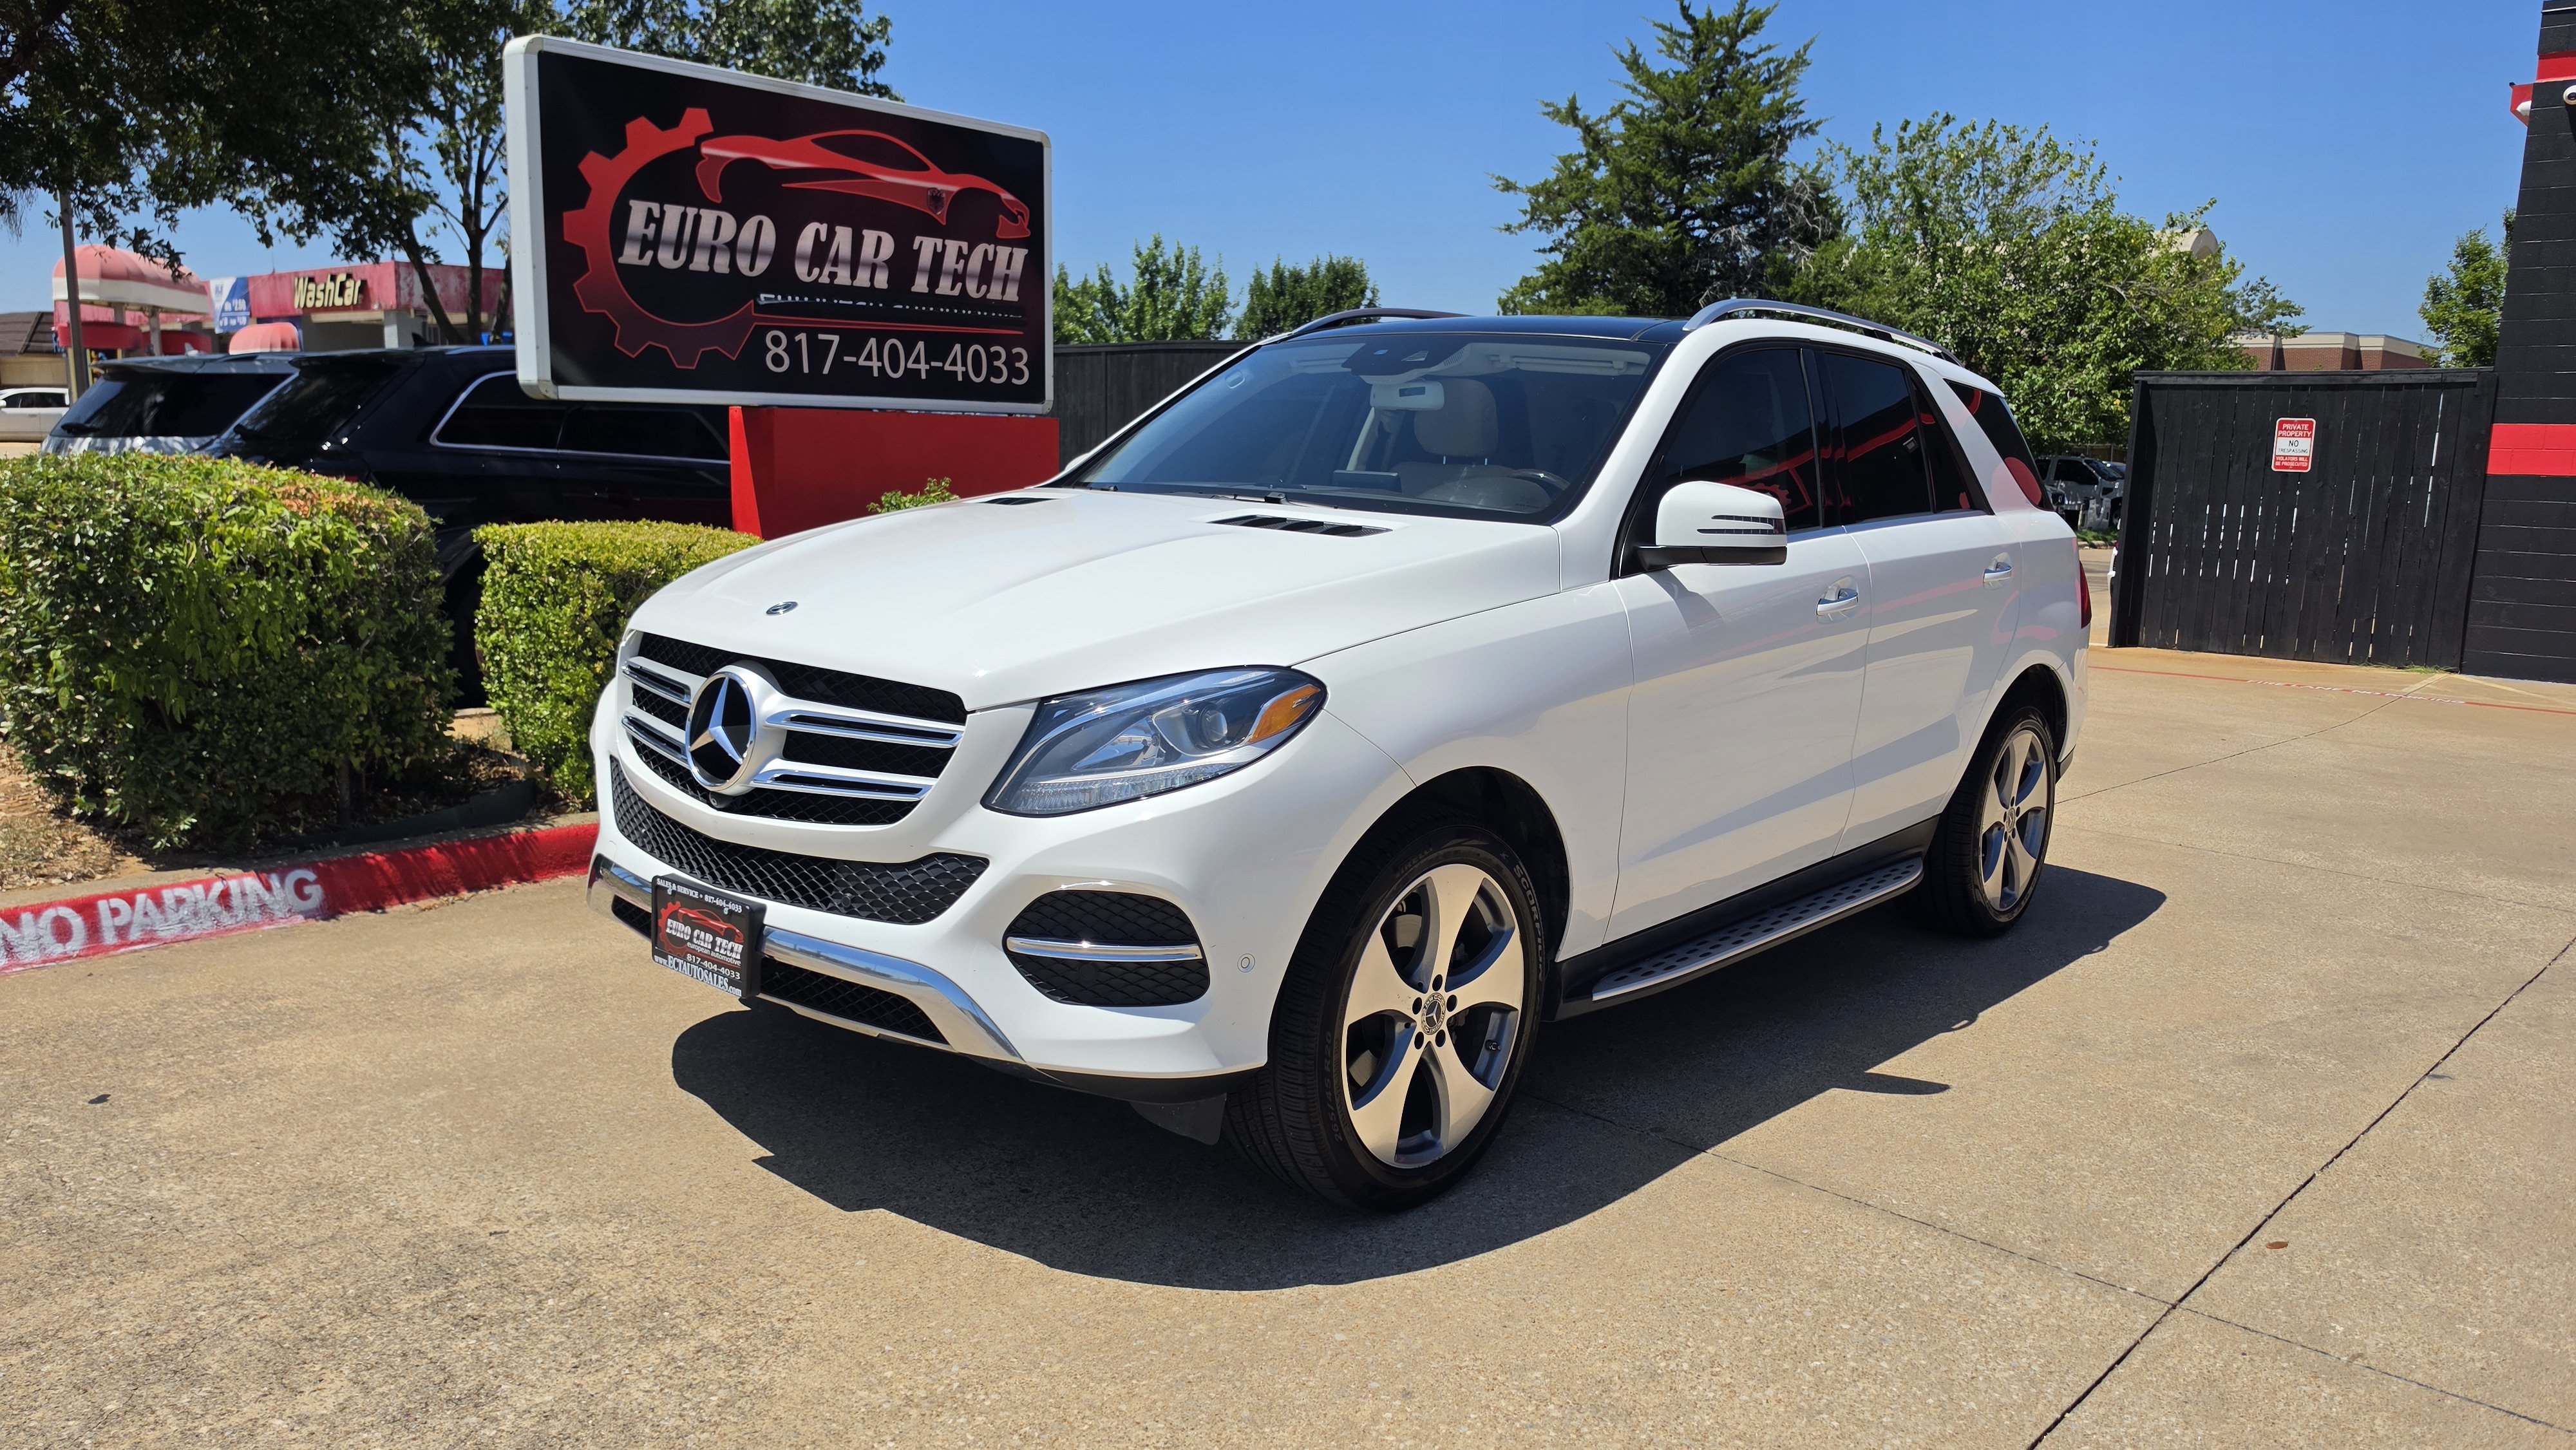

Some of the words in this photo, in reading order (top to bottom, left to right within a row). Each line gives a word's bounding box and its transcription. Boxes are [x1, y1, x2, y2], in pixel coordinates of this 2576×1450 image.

[618, 199, 776, 277] EURO
[794, 221, 895, 289] CAR
[911, 235, 1029, 302] TECH
[294, 272, 361, 309] WashCar
[765, 329, 1030, 385] 817-404-4033
[657, 878, 672, 889] SALES
[677, 885, 699, 899] SERVICE
[705, 894, 742, 913] 817-404-4033
[0, 906, 86, 964] NO
[97, 869, 325, 946] PARKING
[665, 918, 692, 941] EURO
[693, 929, 714, 949] CAR
[715, 936, 744, 959] TECH
[687, 942, 710, 955] european
[710, 950, 741, 966] automotive
[654, 954, 742, 997] www.ECTAUTOSALES.com
[687, 953, 741, 980] 817-404-4033
